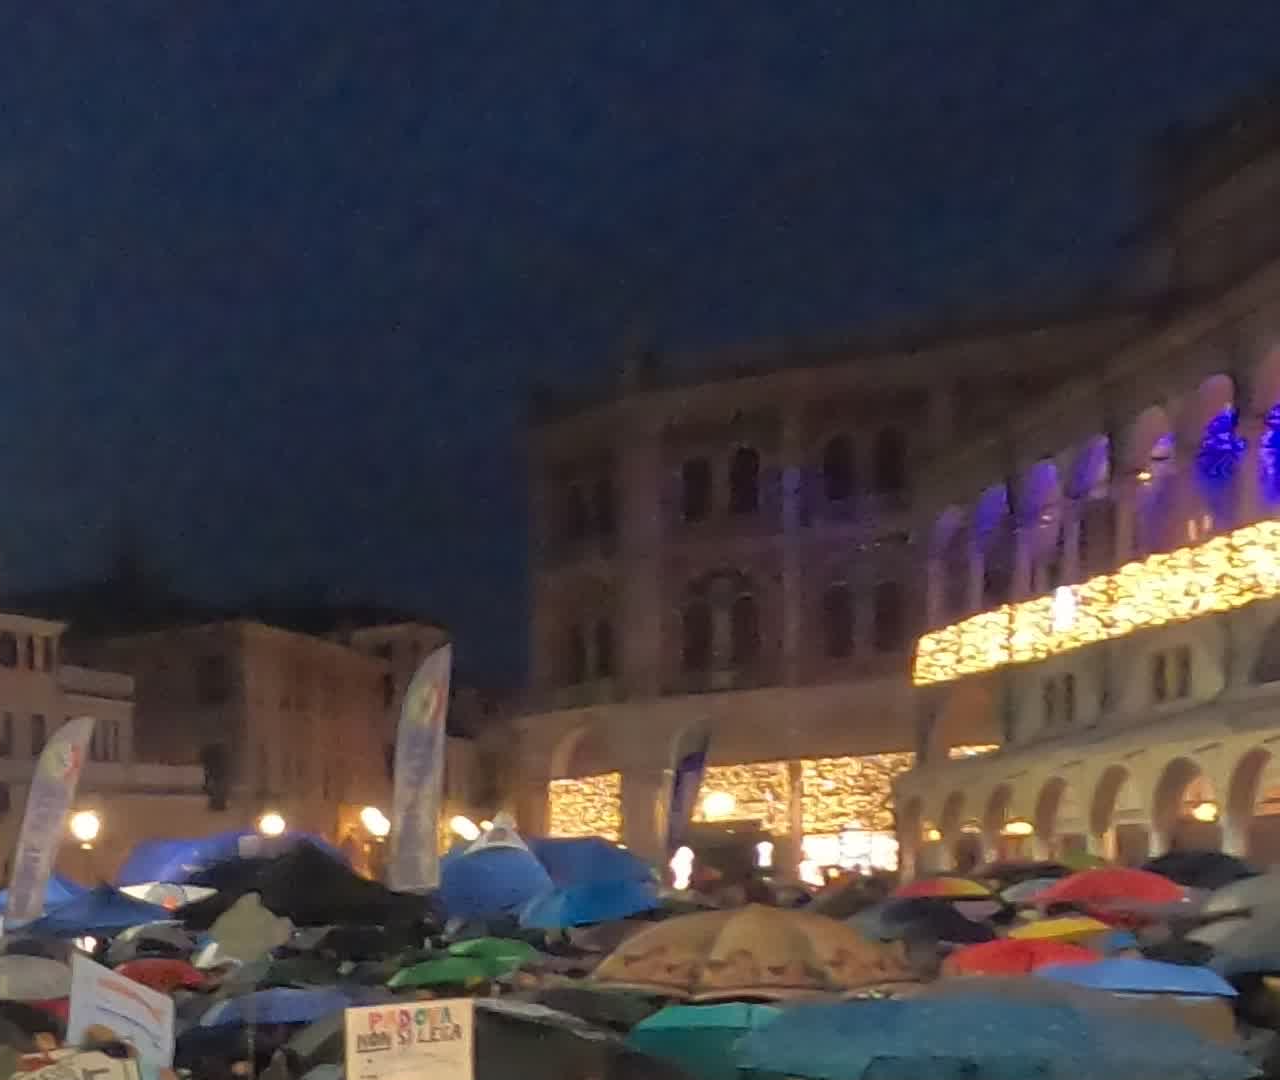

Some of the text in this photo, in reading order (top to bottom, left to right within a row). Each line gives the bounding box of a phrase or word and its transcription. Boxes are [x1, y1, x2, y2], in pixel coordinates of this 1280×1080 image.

[368, 1007, 452, 1030] PADOVA
[357, 1032, 391, 1048] NON
[417, 1023, 462, 1042] LEGA
